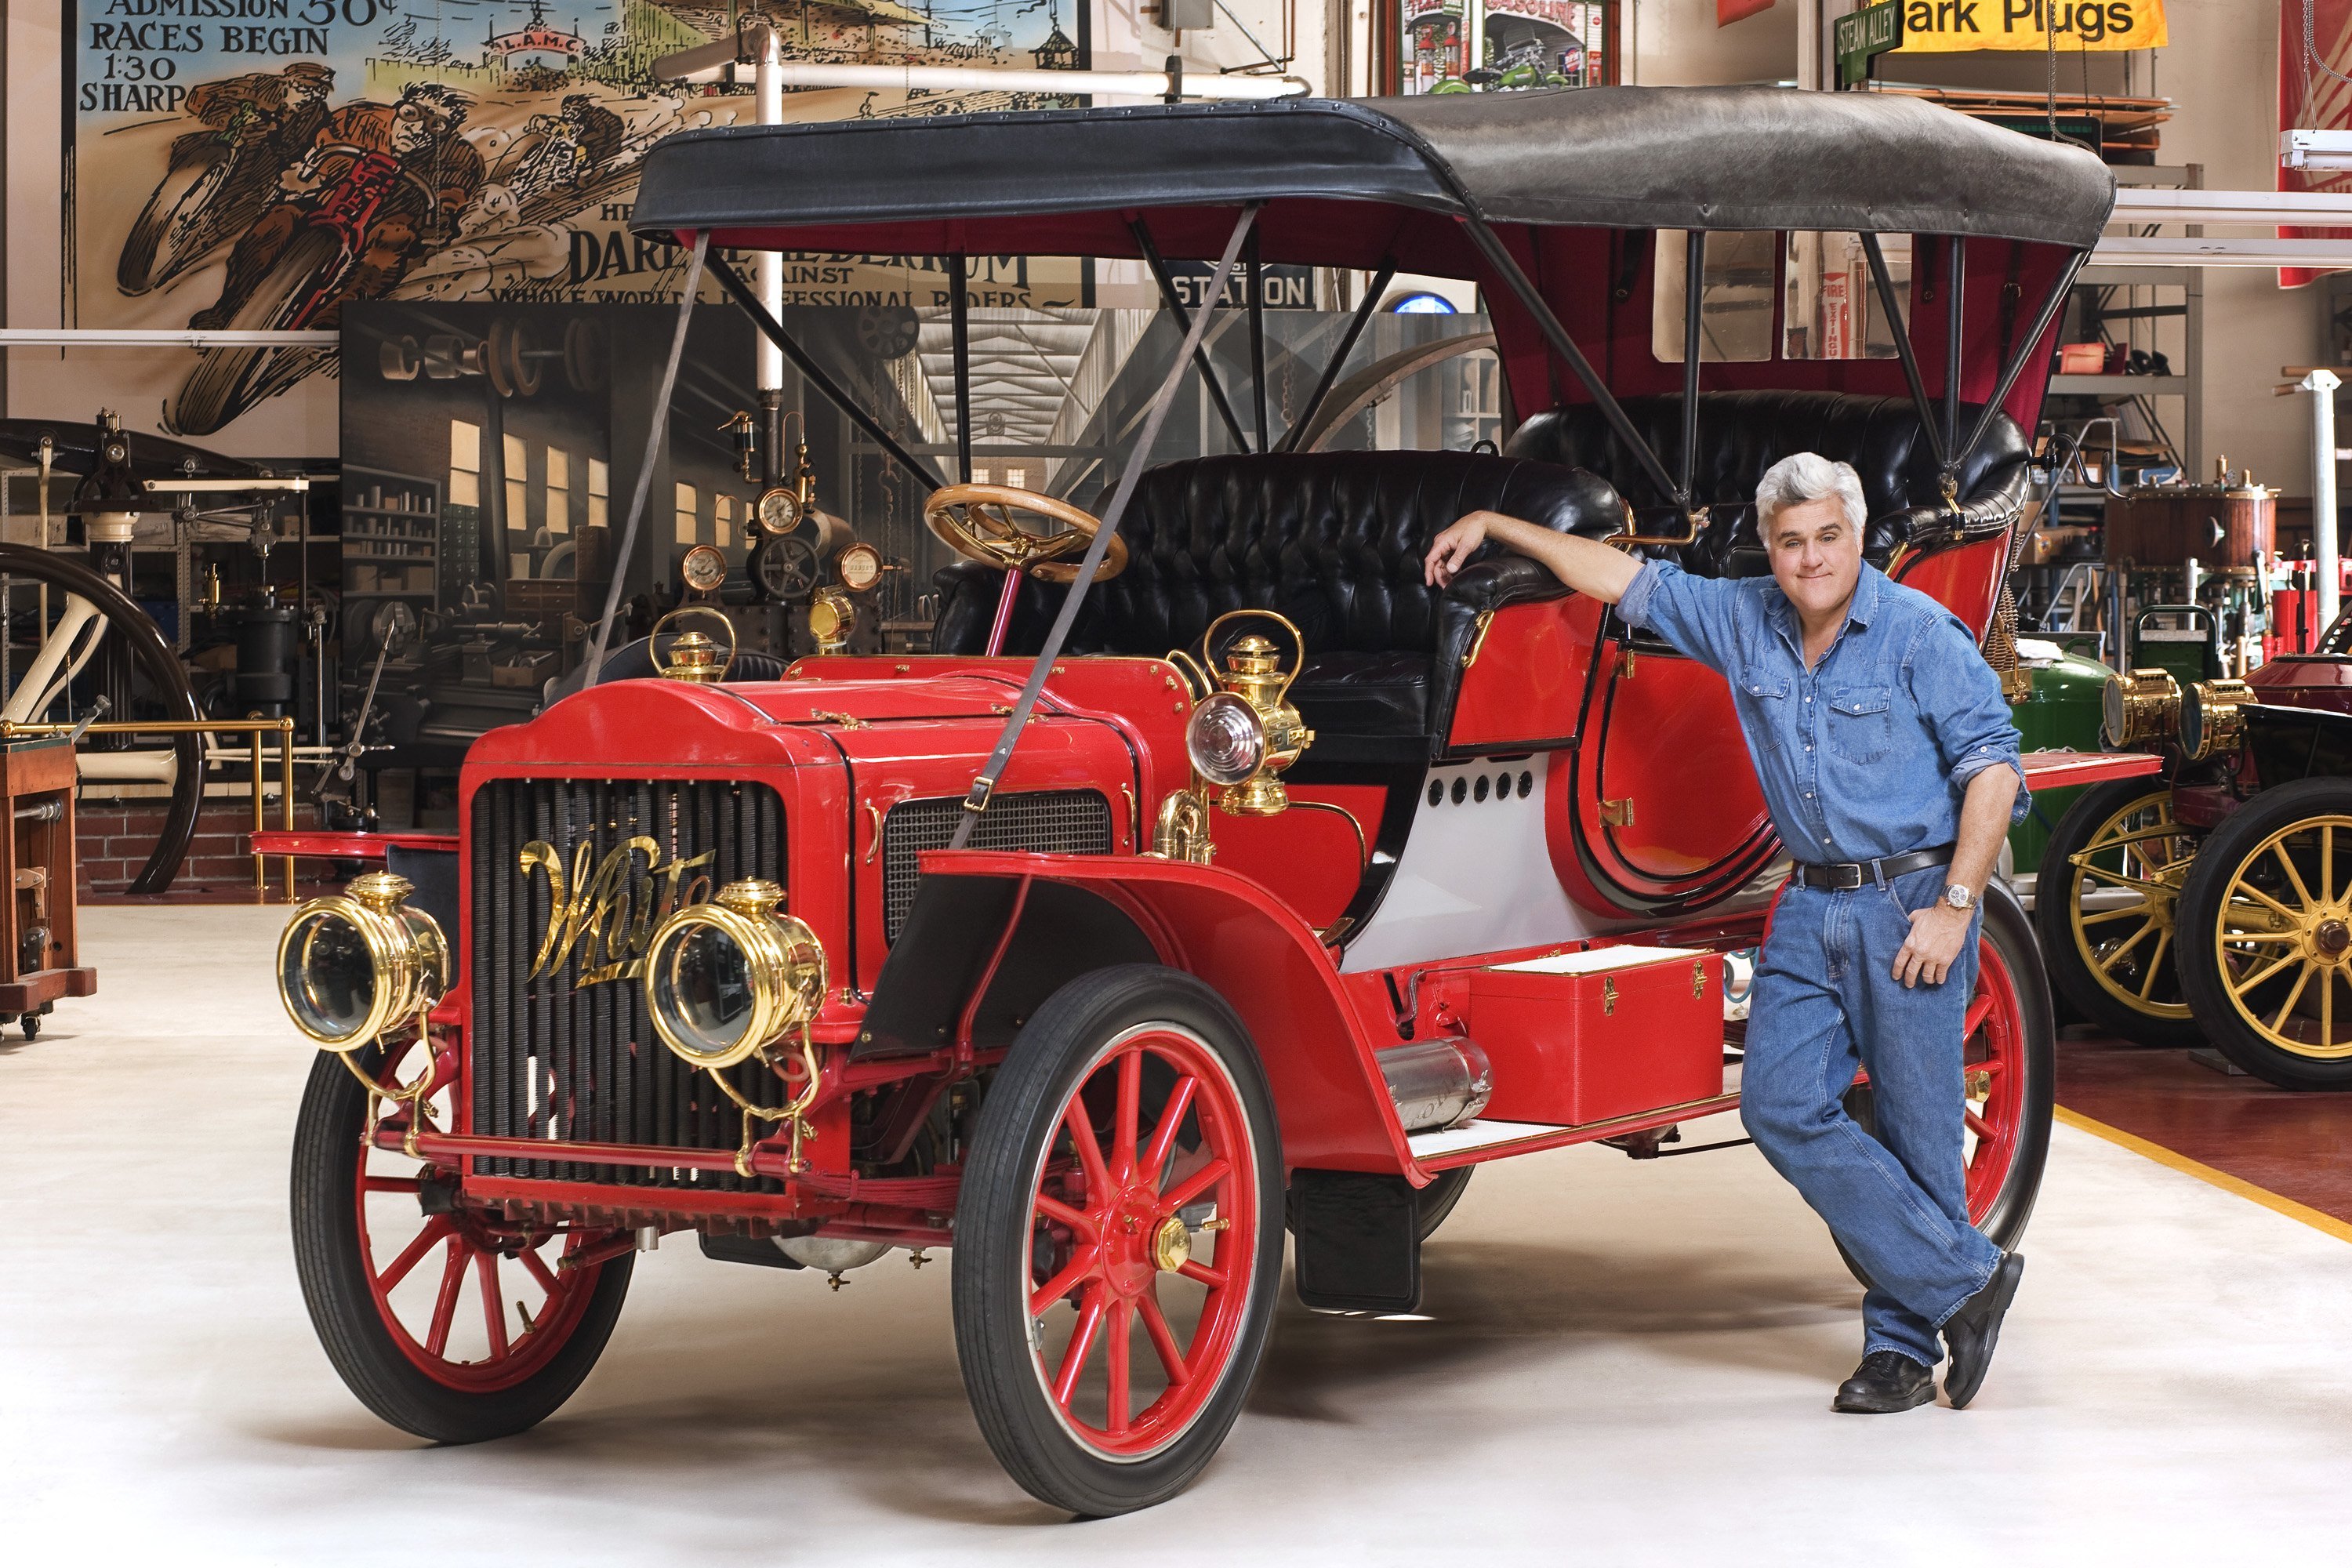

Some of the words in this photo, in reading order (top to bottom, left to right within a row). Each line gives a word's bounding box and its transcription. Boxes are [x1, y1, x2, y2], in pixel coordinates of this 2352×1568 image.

[1839, 16, 1866, 56] STEAM
[1868, 6, 1896, 46] ALLEY
[2004, 0, 2134, 42] Plugs
[89, 20, 204, 53] RACES
[220, 26, 330, 56] BEGIN
[504, 34, 579, 53] L.A.M.C.
[103, 53, 176, 82] 1:30
[80, 82, 187, 112] SHARP
[734, 265, 855, 284] AINST
[930, 290, 1032, 309] RDERS
[1171, 276, 1305, 305] STATON
[1823, 284, 1846, 298] FIRE
